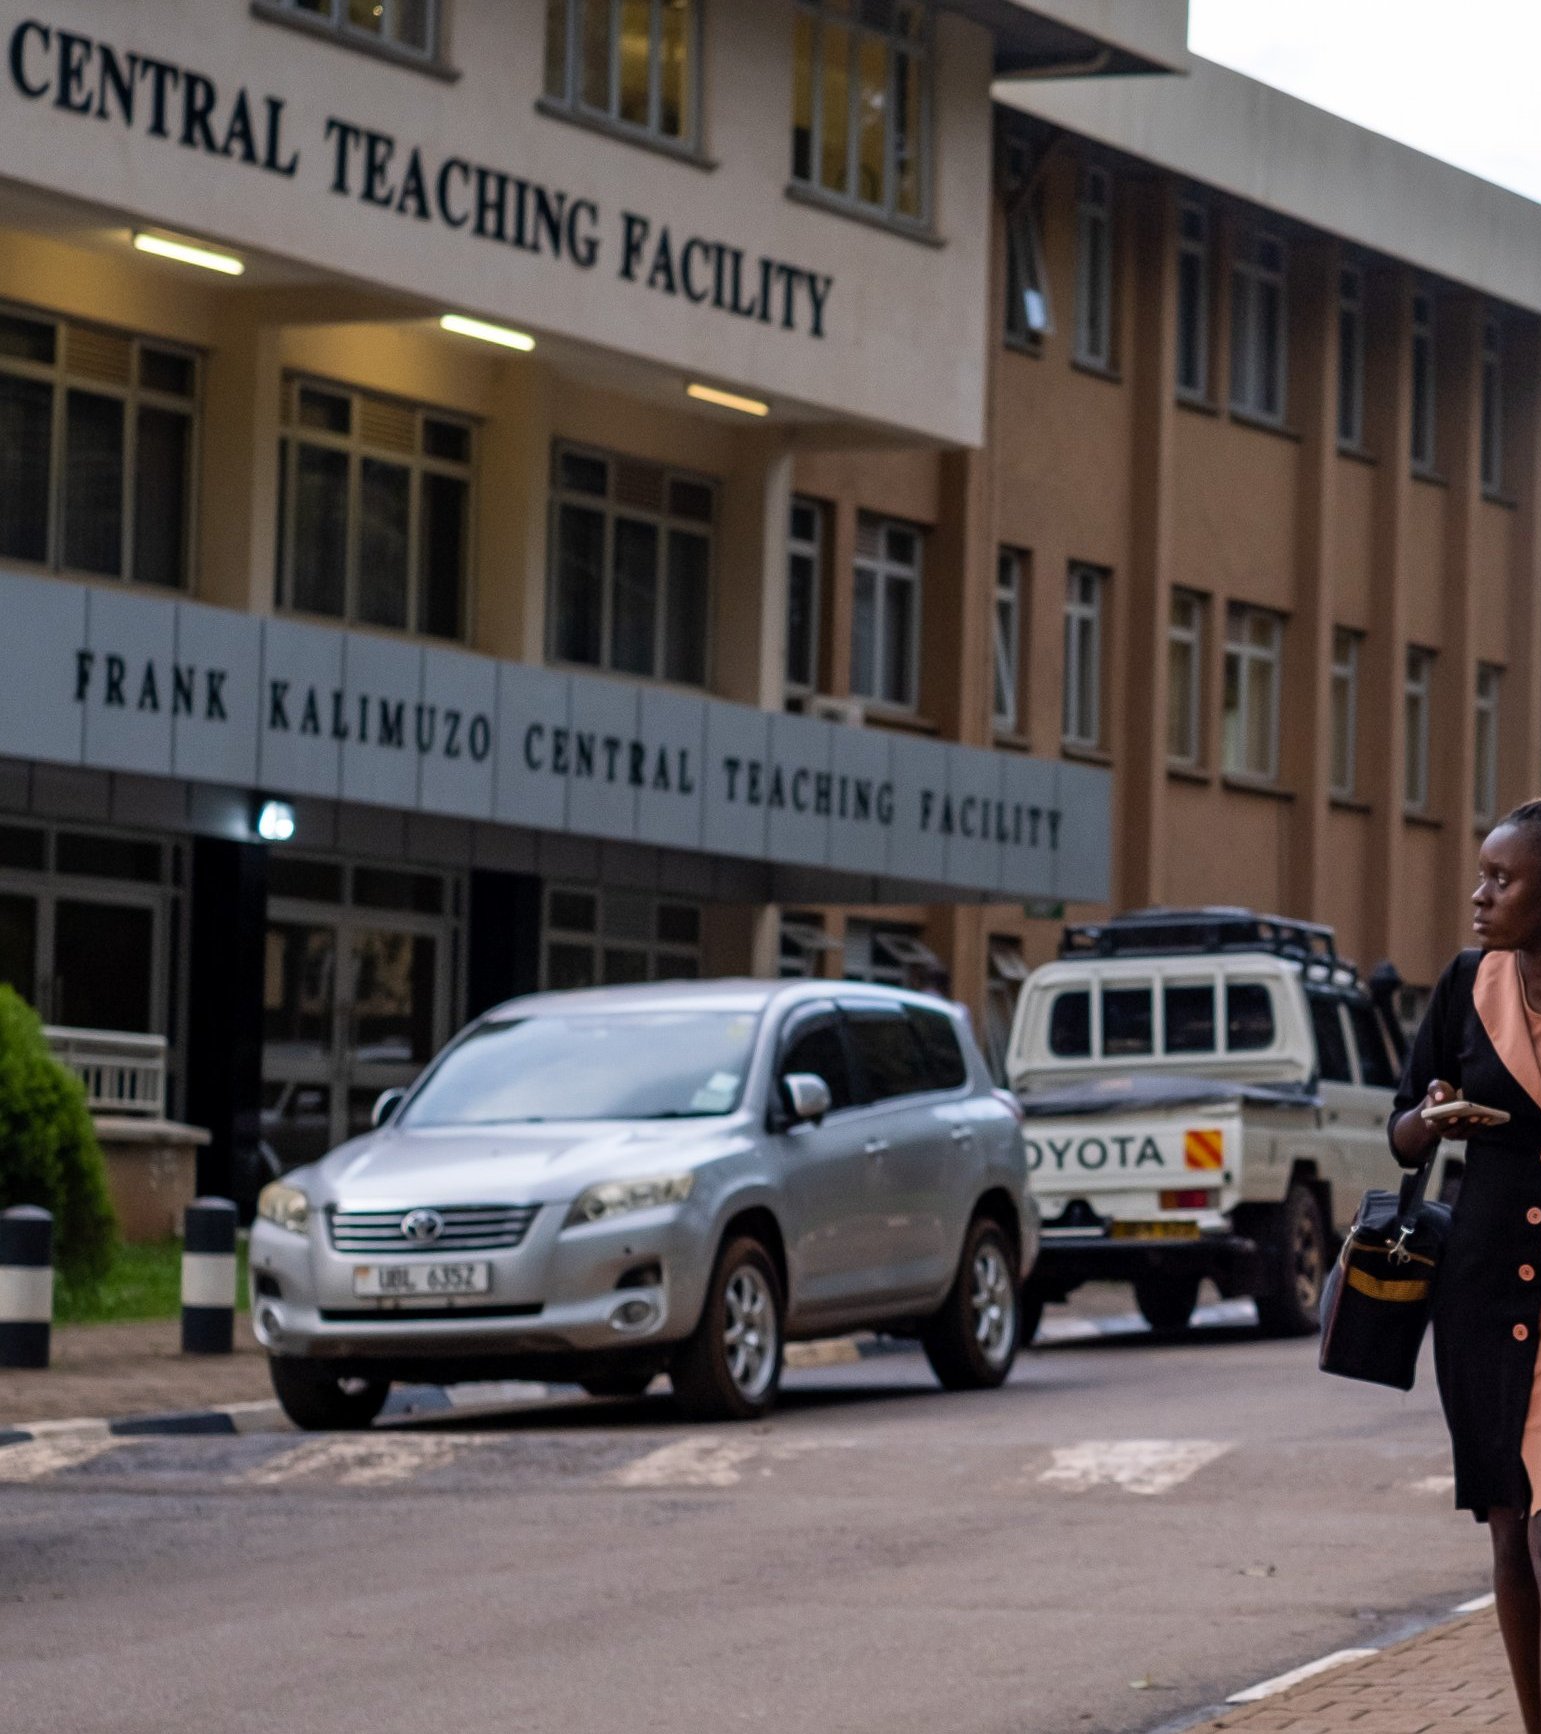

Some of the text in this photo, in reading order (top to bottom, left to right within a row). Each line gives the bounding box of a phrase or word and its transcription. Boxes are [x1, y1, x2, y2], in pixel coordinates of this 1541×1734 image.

[8, 20, 834, 339] CENTRAL TEACHING FACILITY
[74, 649, 1064, 852] FRANK KALIMUZO CENTRAL TEACHING FACILITY
[1025, 1136, 1164, 1171] OYOTA
